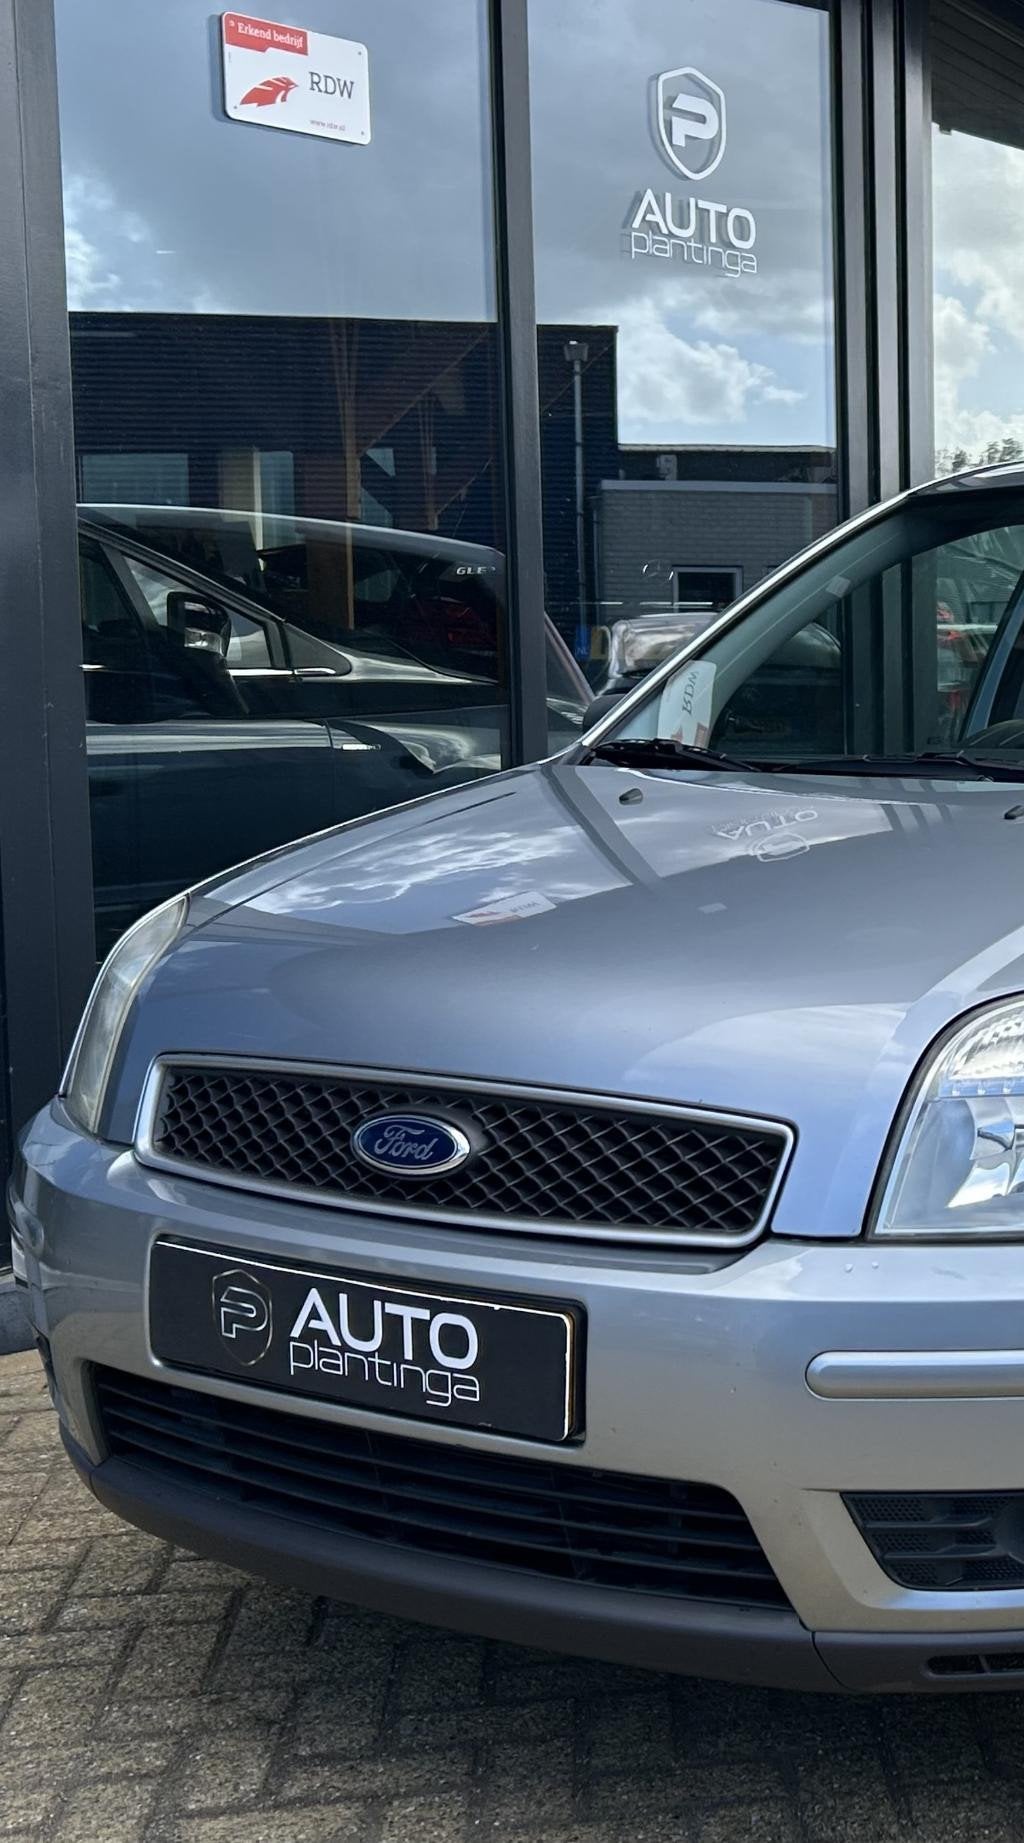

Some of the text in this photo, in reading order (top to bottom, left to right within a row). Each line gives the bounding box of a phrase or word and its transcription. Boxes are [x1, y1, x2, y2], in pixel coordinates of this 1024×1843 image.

[237, 22, 303, 48] Erkend bedrijf
[309, 71, 354, 99] RDW
[632, 188, 756, 249] AUTO
[631, 230, 757, 278] plantinga
[374, 1124, 440, 1161] Ford
[289, 1287, 478, 1370] AUTO
[289, 1338, 480, 1407] plantinga
